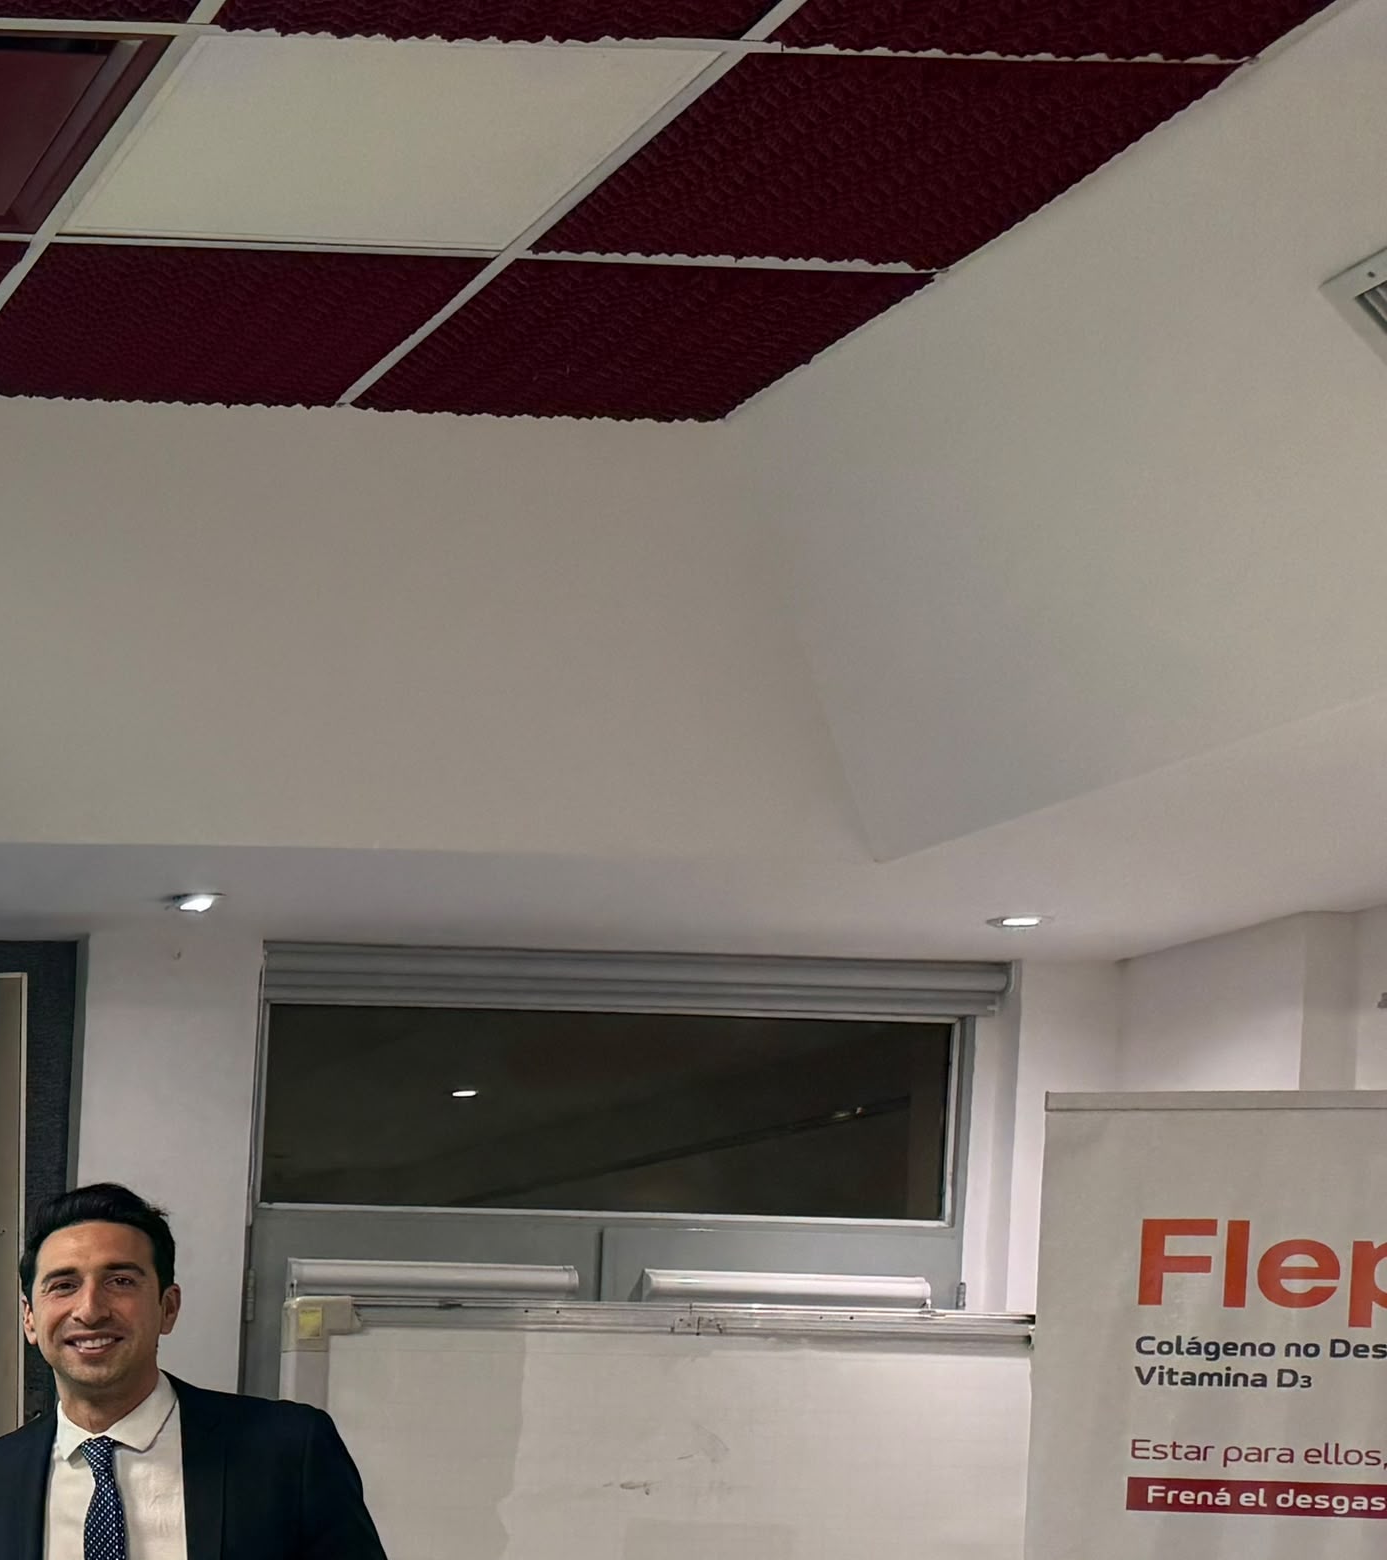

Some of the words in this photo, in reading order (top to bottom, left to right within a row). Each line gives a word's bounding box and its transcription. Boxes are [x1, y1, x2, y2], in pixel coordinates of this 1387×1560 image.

[1135, 1335, 1276, 1361] Colágeno
[1284, 1342, 1320, 1358] no
[1329, 1338, 1387, 1359] Des
[1134, 1366, 1267, 1388] Vitamina
[1277, 1368, 1312, 1388] D3
[1131, 1439, 1215, 1461] Estar
[1223, 1445, 1294, 1467] para
[1147, 1485, 1231, 1506] Frená
[1239, 1488, 1267, 1507] el
